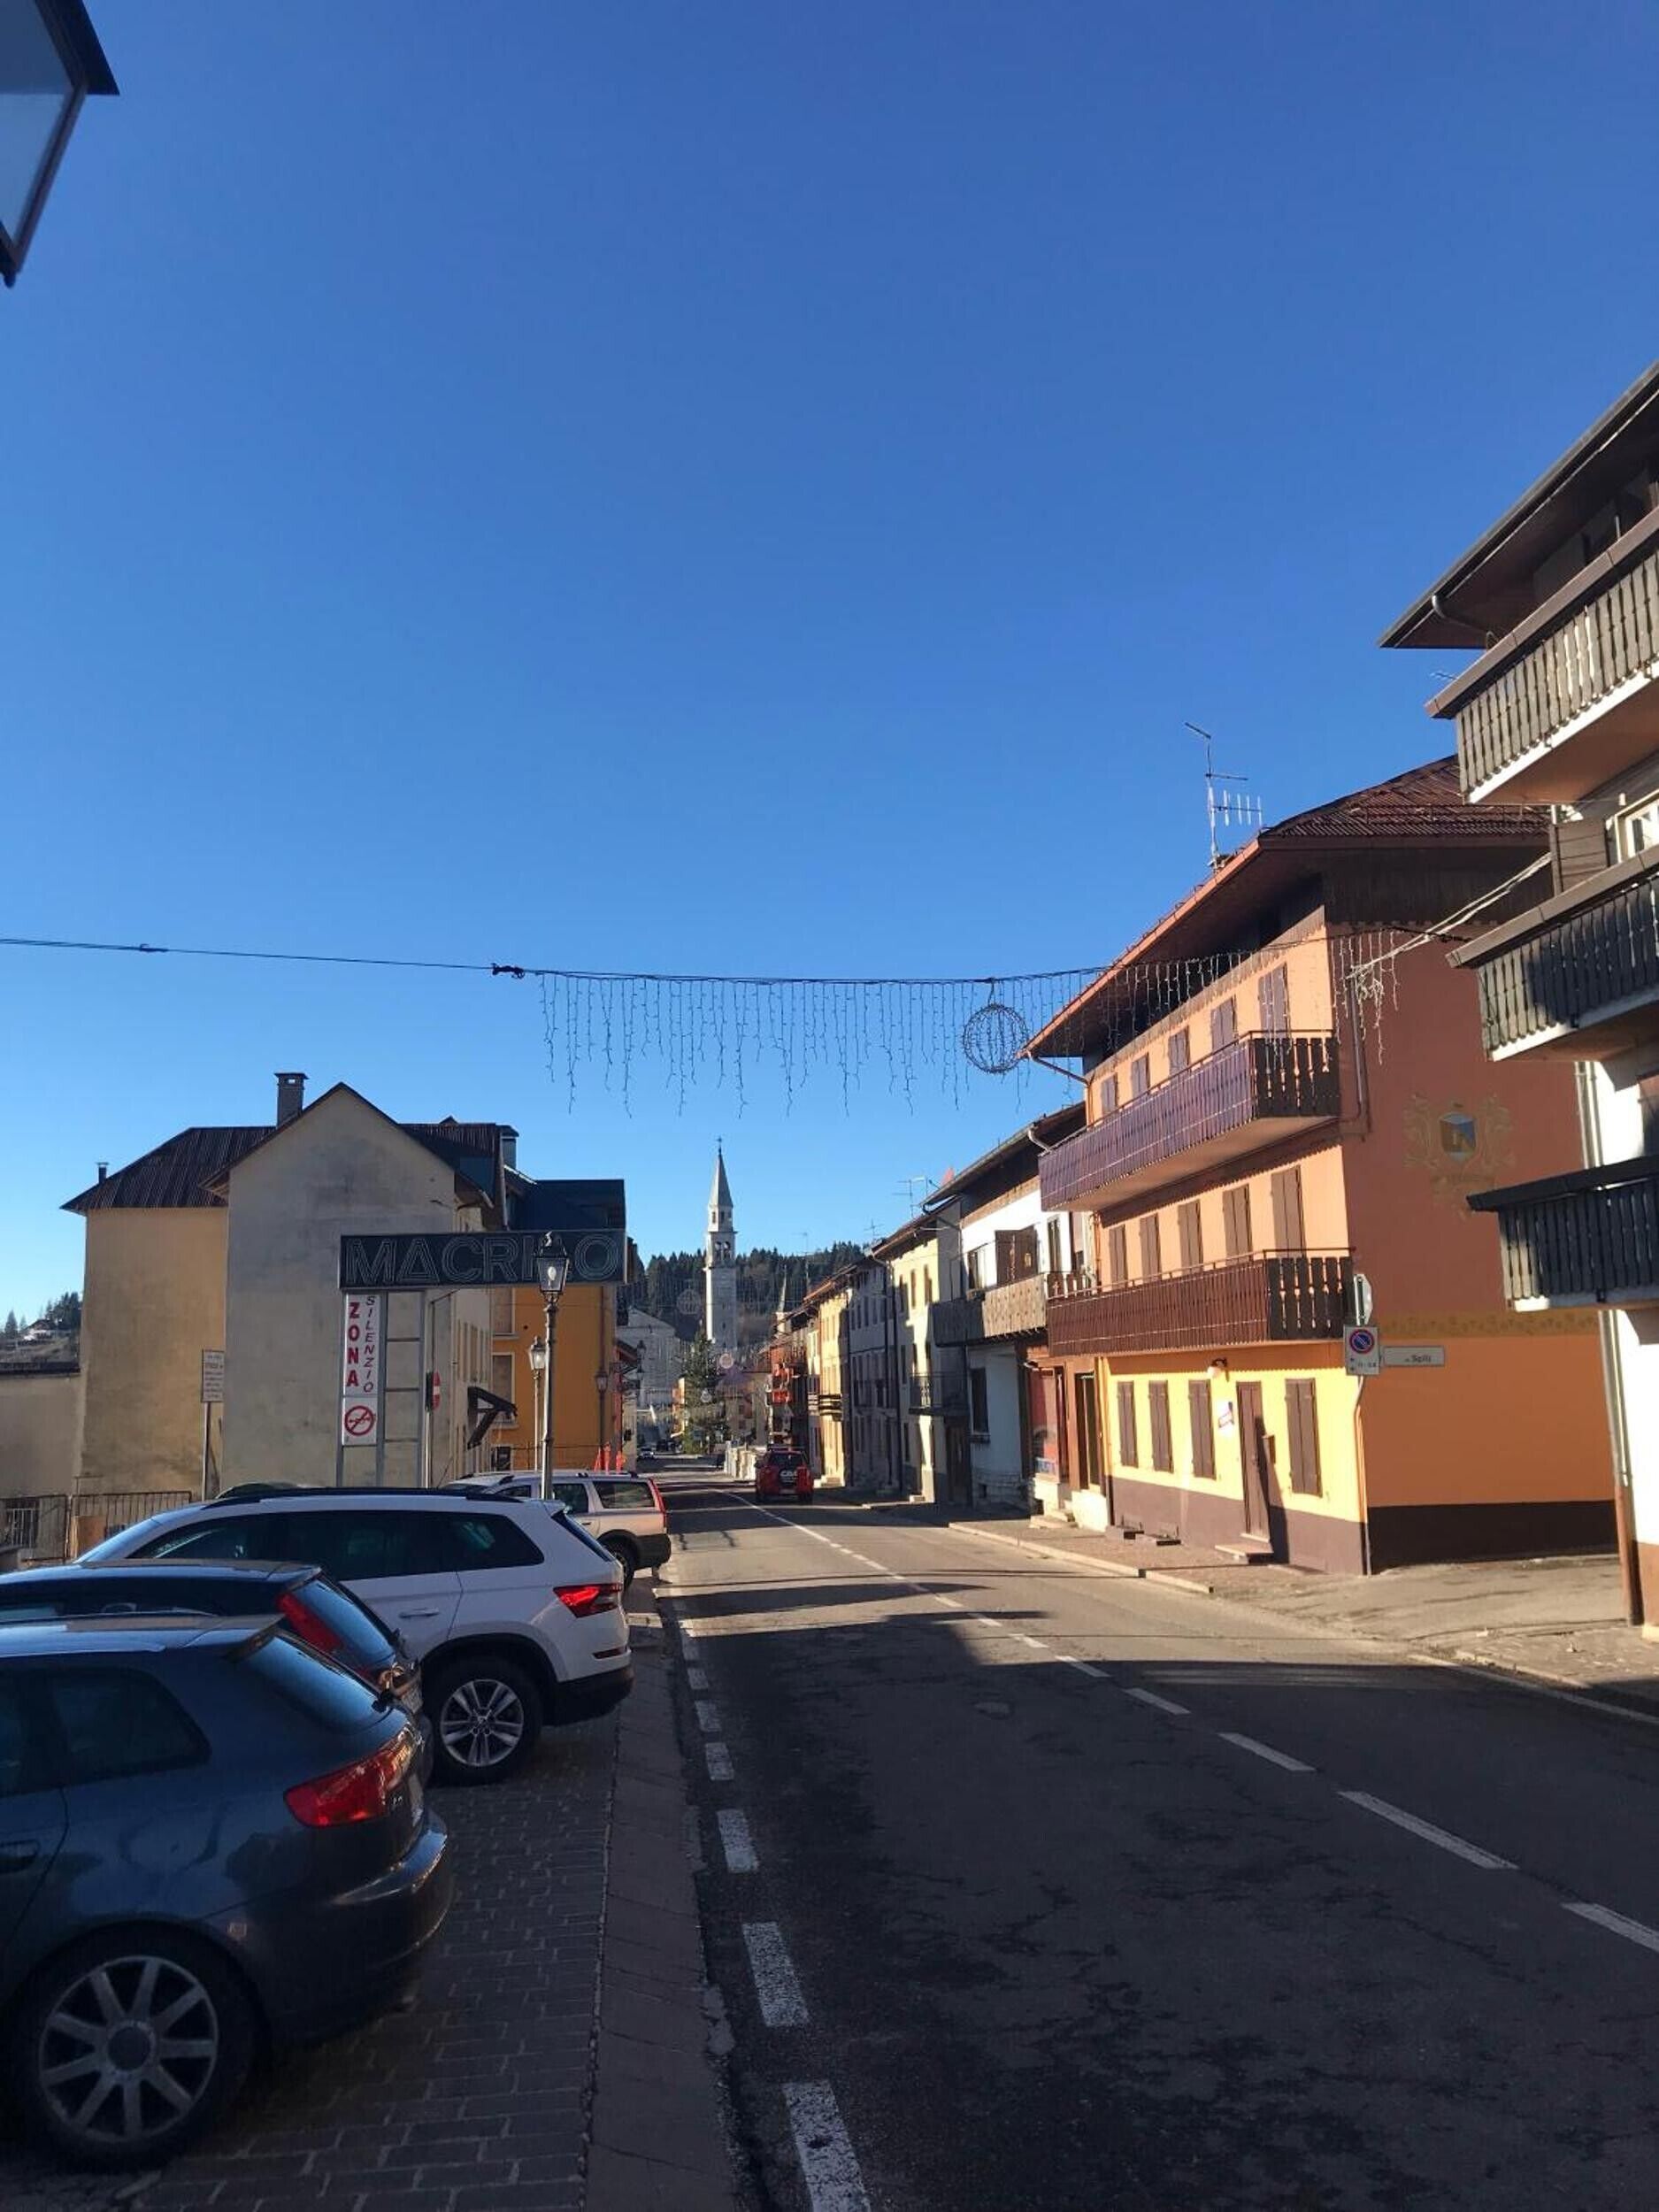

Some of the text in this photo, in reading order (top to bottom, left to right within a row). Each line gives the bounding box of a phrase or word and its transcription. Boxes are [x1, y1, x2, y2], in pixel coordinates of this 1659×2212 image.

[346, 1235, 618, 1283] MACRIO
[346, 1302, 360, 1386] ZONA
[363, 1295, 376, 1393] SILENZIO
